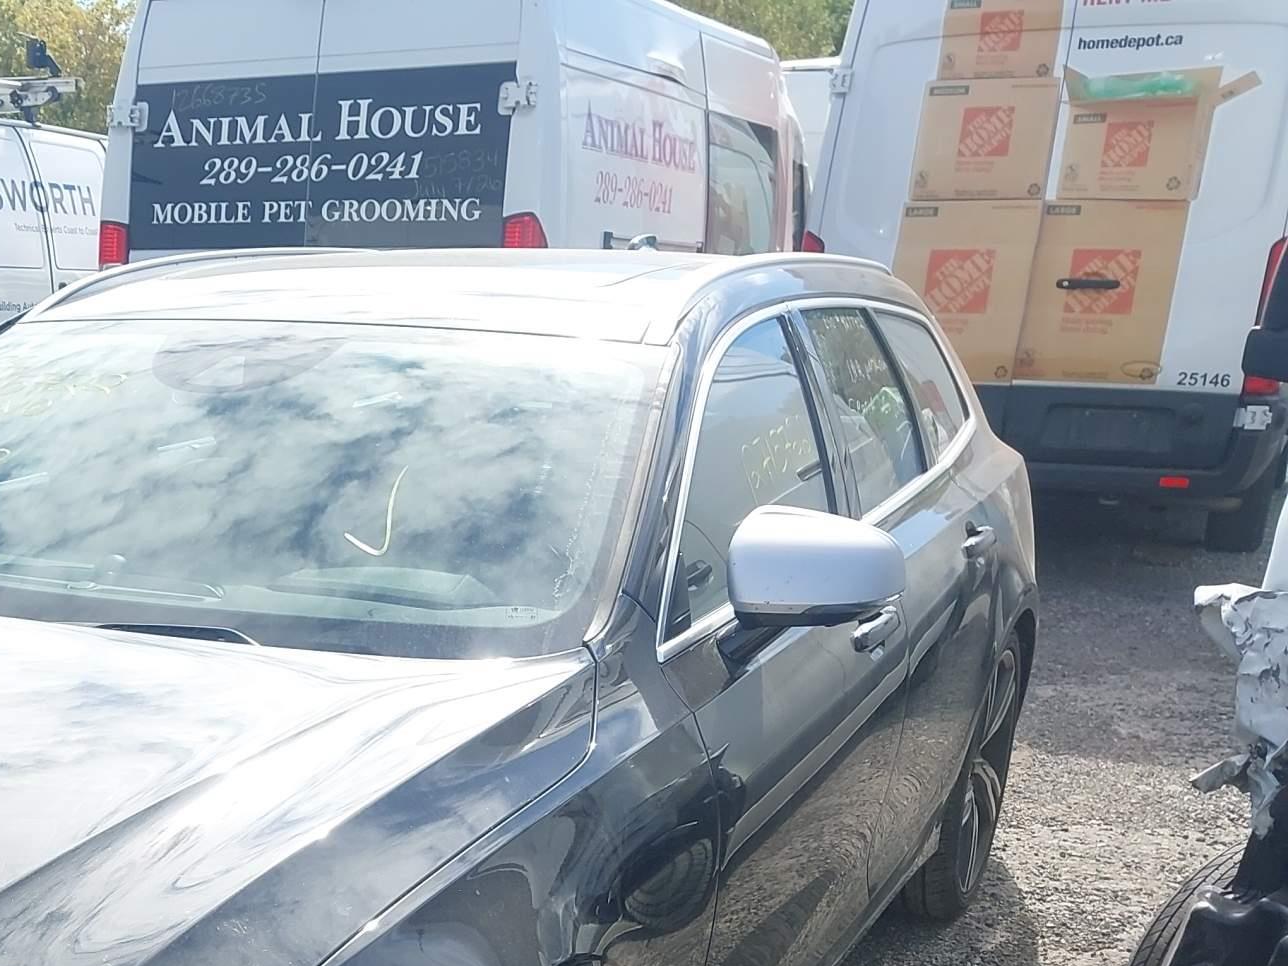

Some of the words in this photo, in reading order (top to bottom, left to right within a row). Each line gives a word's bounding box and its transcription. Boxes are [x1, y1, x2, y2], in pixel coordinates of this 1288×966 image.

[1077, 33, 1184, 51] homedepot.ca
[153, 109, 323, 148] ANIMAL
[335, 98, 482, 141] HOUSE
[582, 100, 649, 163] ANIMAL
[652, 120, 696, 173] HOUSE
[200, 150, 425, 186] 289-286-0241
[151, 201, 252, 225] MOBILE
[262, 200, 312, 223] PET
[322, 198, 482, 222] GROOMING
[1176, 371, 1231, 388] 25146
